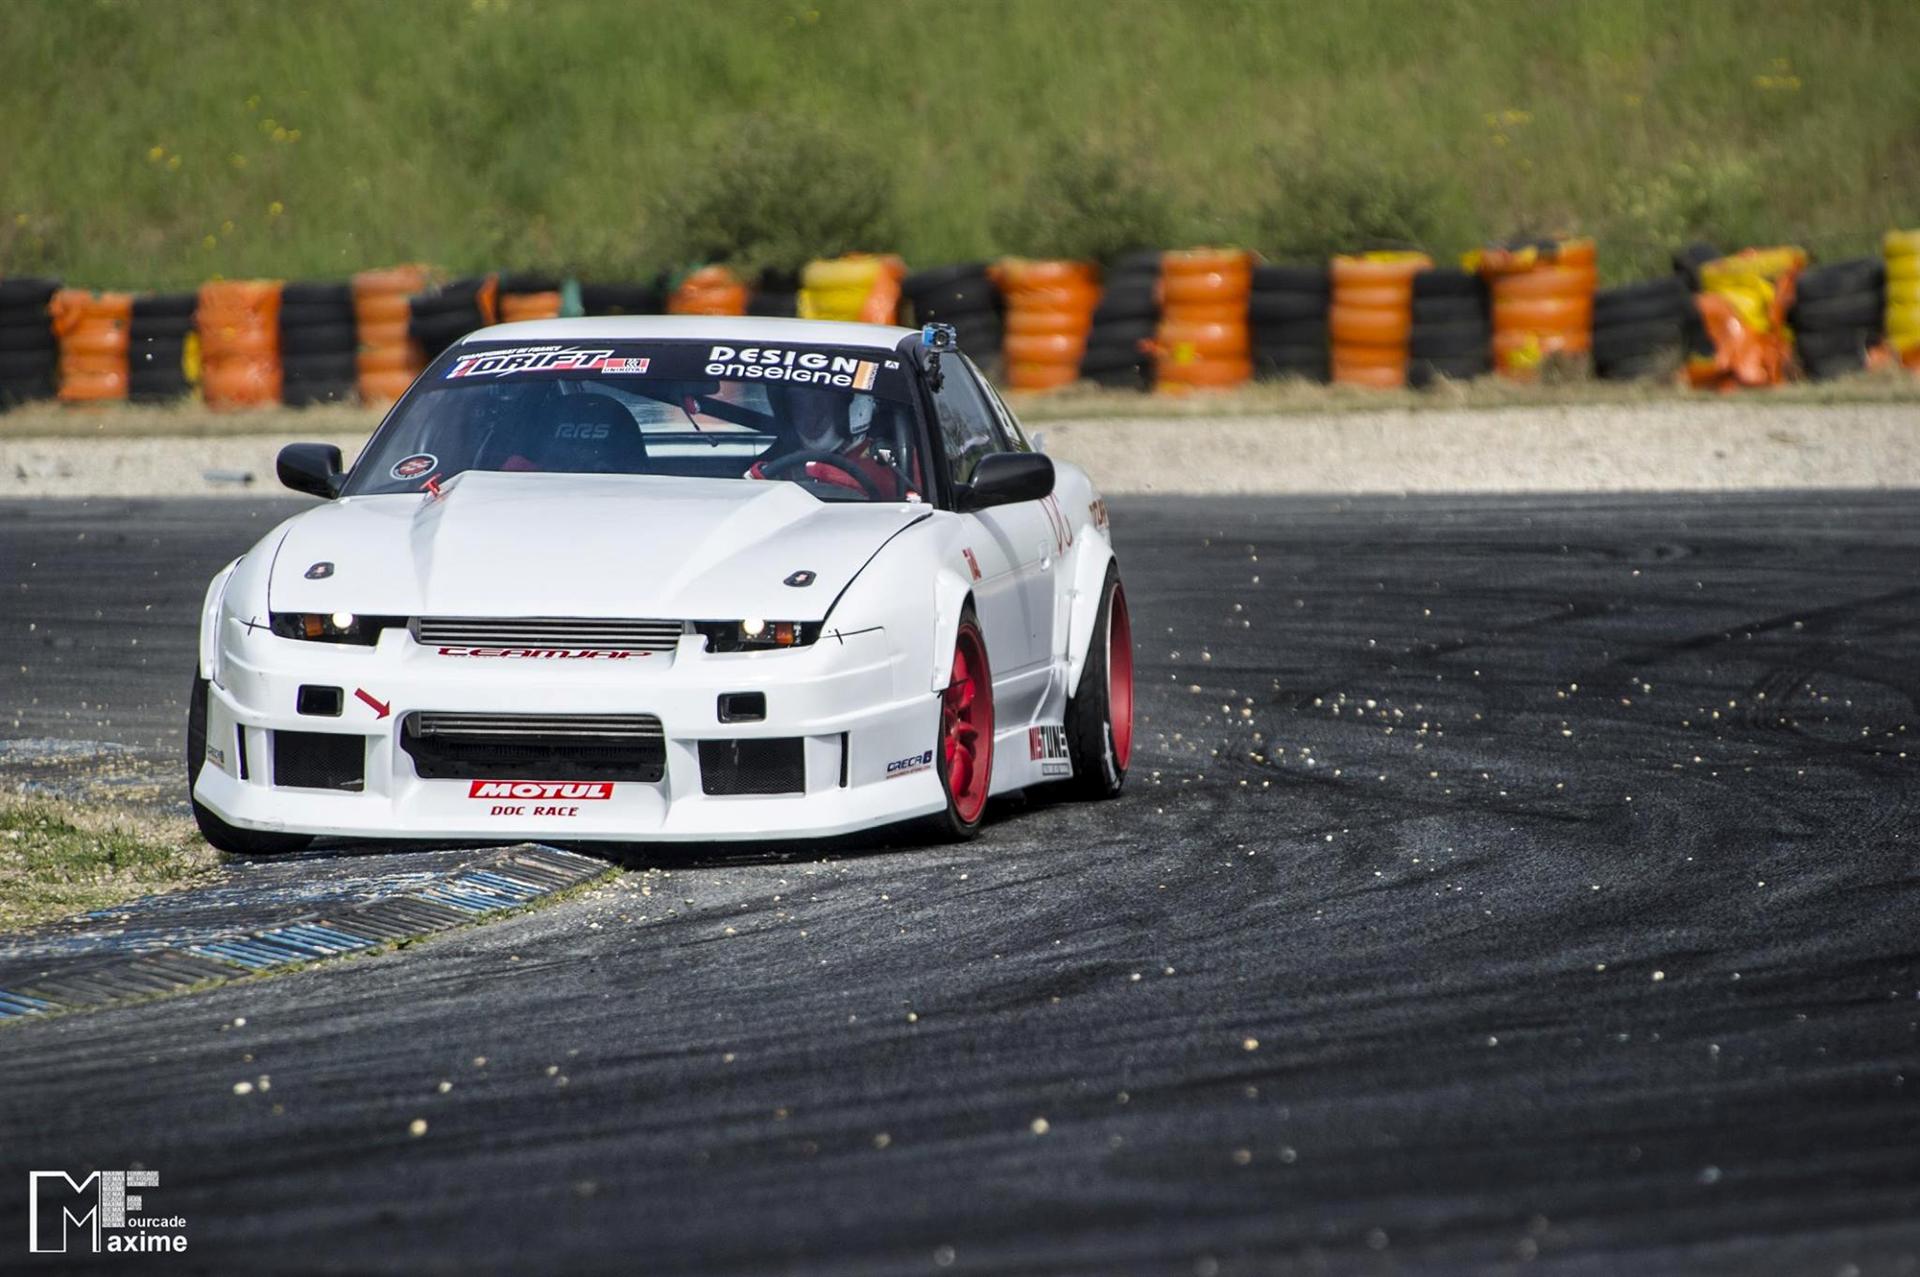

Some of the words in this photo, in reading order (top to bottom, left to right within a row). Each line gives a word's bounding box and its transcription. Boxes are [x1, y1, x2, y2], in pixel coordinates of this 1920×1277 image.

[467, 350, 614, 375] DRIFT
[708, 345, 858, 374] DESIGN
[705, 363, 852, 387] enseigne
[554, 423, 610, 439] RRS
[475, 783, 606, 798] MOTUL
[490, 805, 526, 816] DOC
[532, 806, 579, 817] RACE
